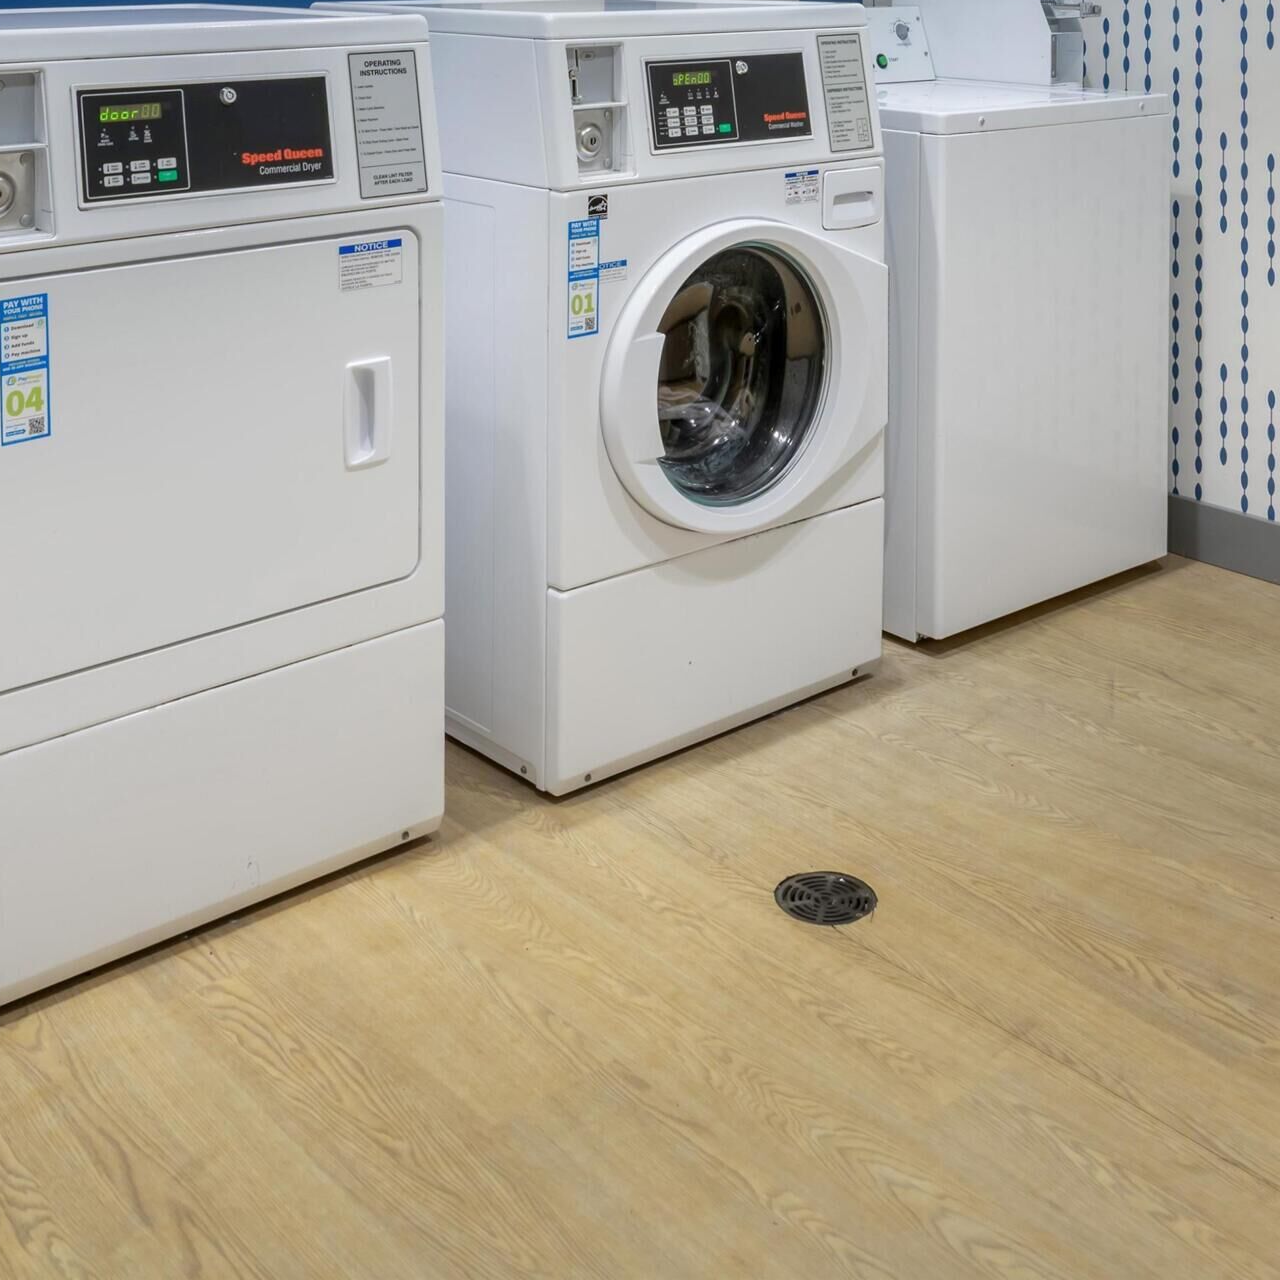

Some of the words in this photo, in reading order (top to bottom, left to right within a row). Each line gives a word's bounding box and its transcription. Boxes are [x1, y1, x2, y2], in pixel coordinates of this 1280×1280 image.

[364, 59, 401, 68] OPERATING
[360, 68, 407, 76] INSTRUCTIONS
[242, 149, 282, 166] Speed
[283, 148, 323, 160] Queen
[260, 164, 301, 175] Commercial
[302, 162, 321, 172] Dryer
[354, 241, 389, 252] NOTICE
[3, 300, 19, 309] PAY
[20, 296, 43, 306] WITH
[571, 293, 594, 315] 01
[6, 386, 45, 417] 04
